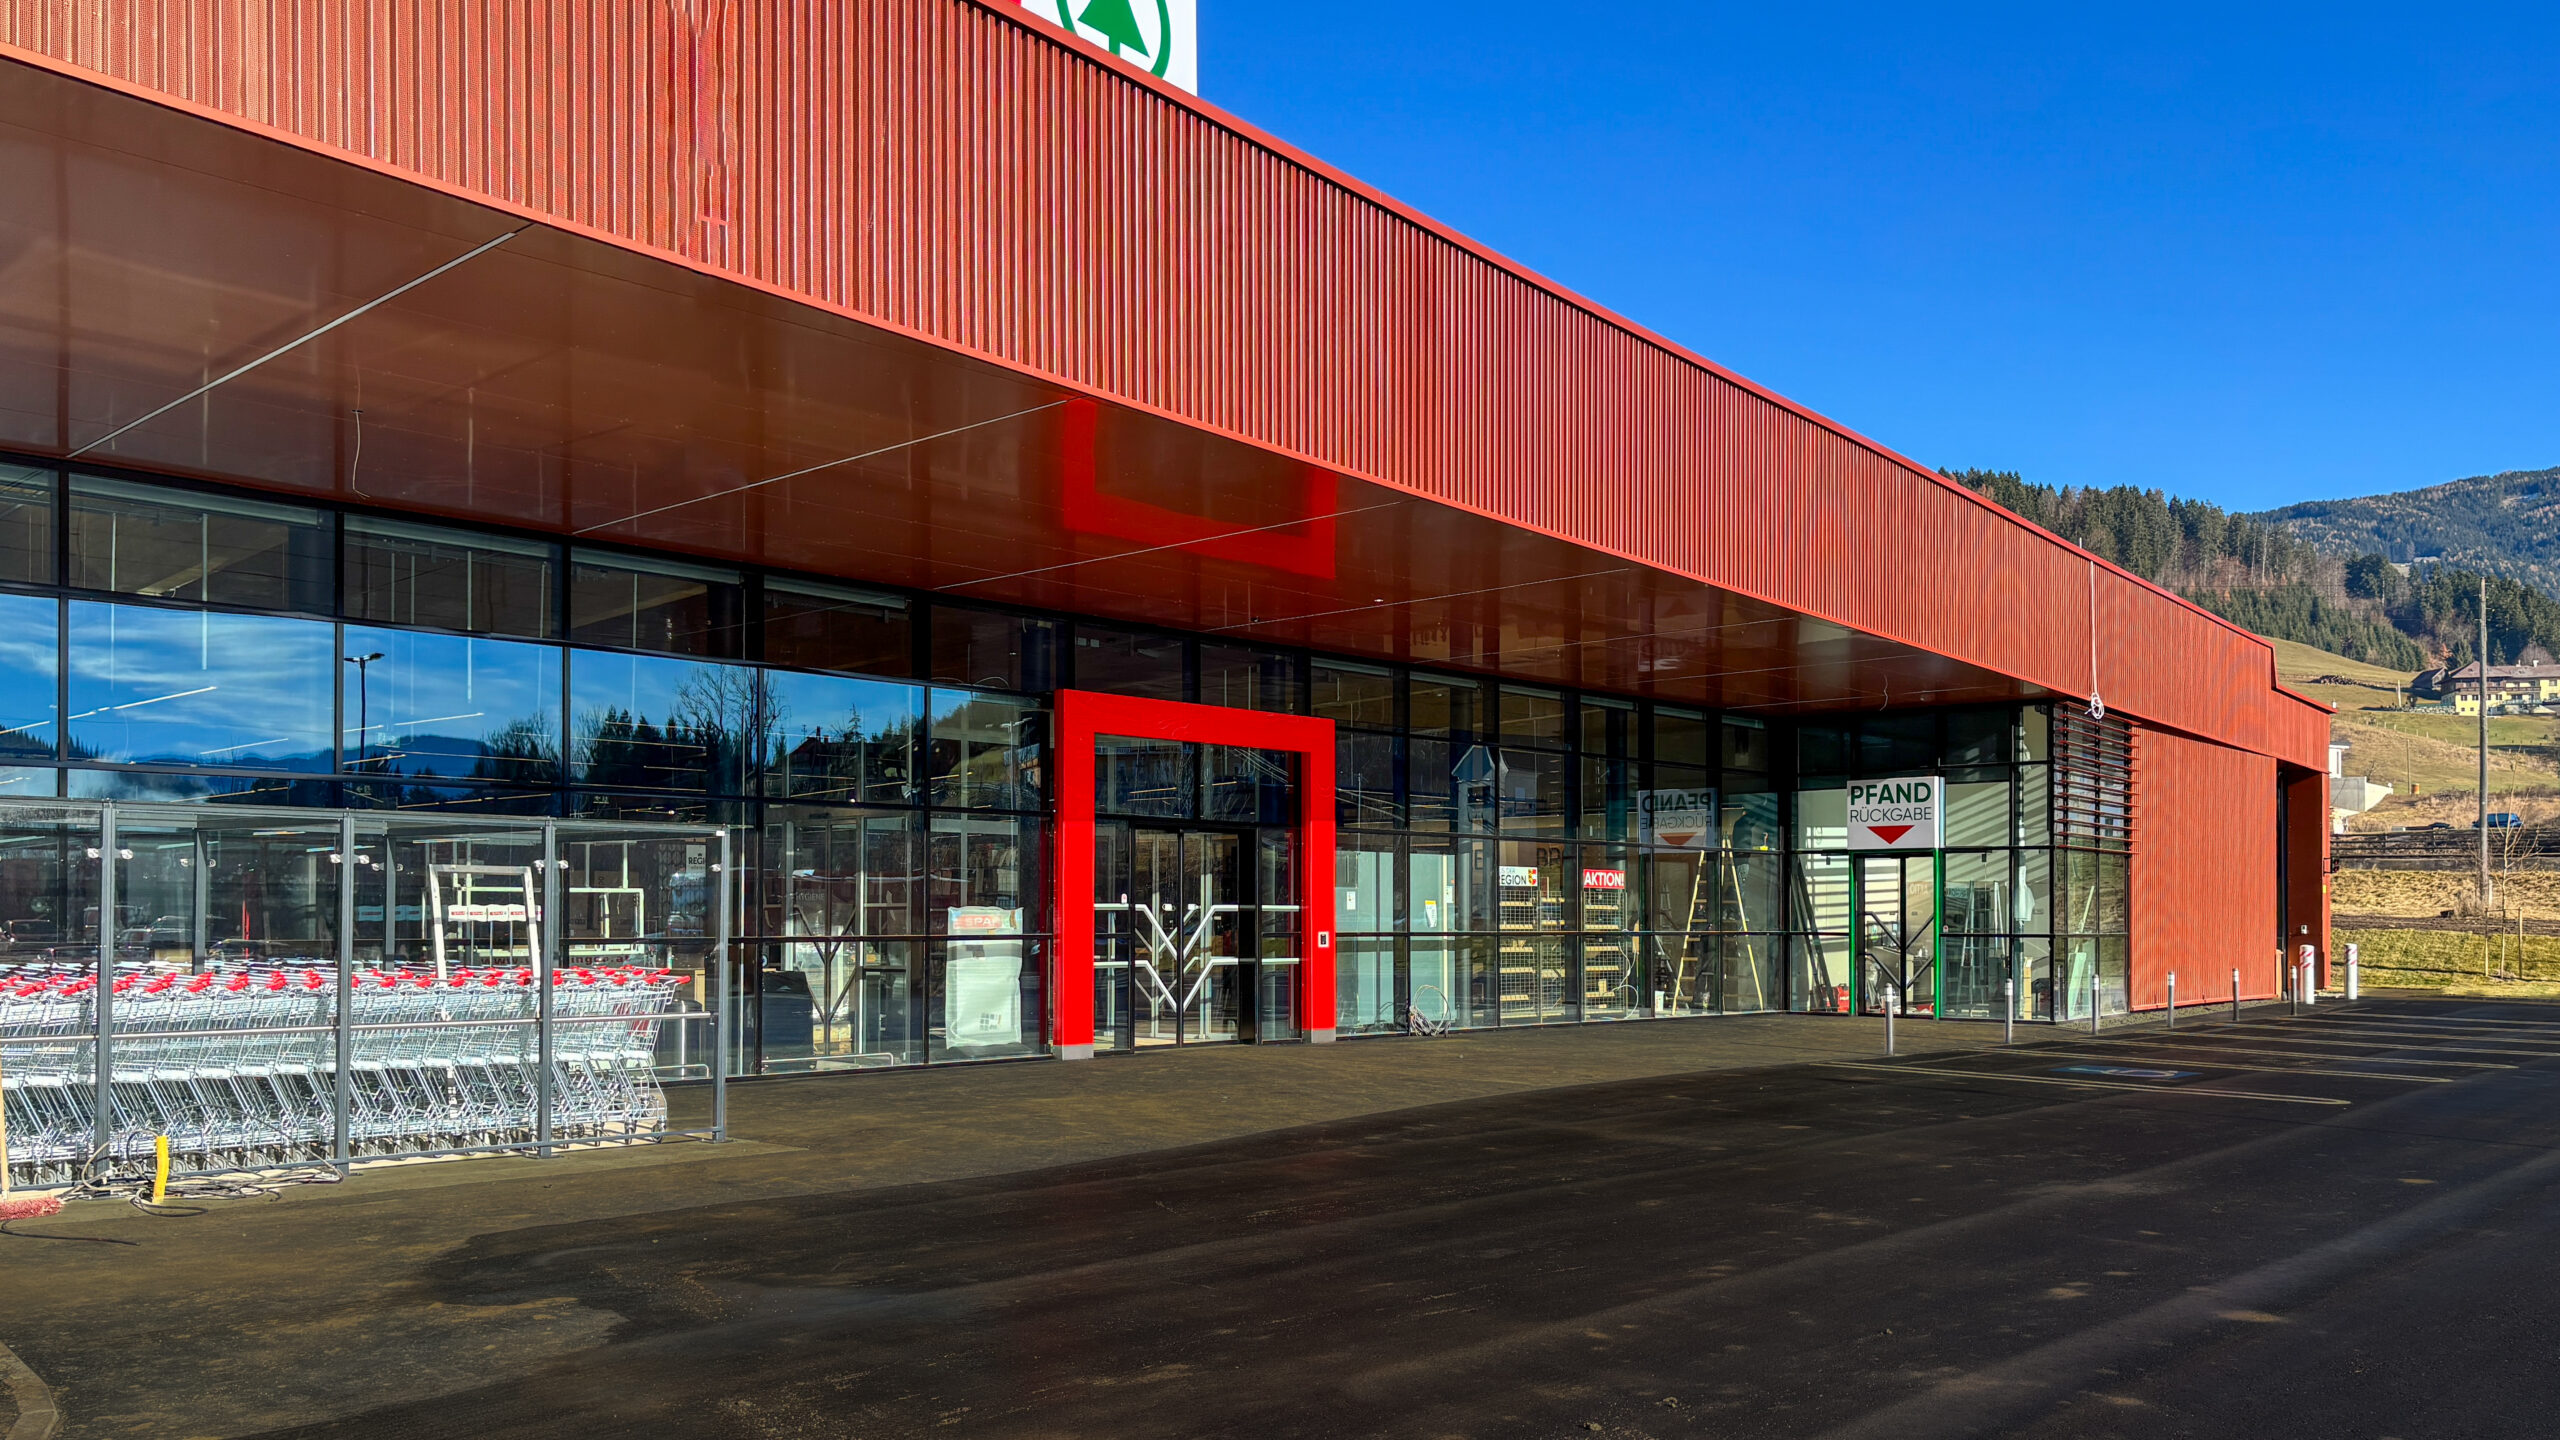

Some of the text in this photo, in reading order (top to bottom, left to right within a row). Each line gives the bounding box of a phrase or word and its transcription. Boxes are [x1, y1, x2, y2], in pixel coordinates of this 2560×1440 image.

[1850, 783, 1931, 805] PFAND
[1850, 806, 1932, 822] RÜCKGABE
[1501, 874, 1527, 885] EGION
[1584, 872, 1625, 887] AKTION!
